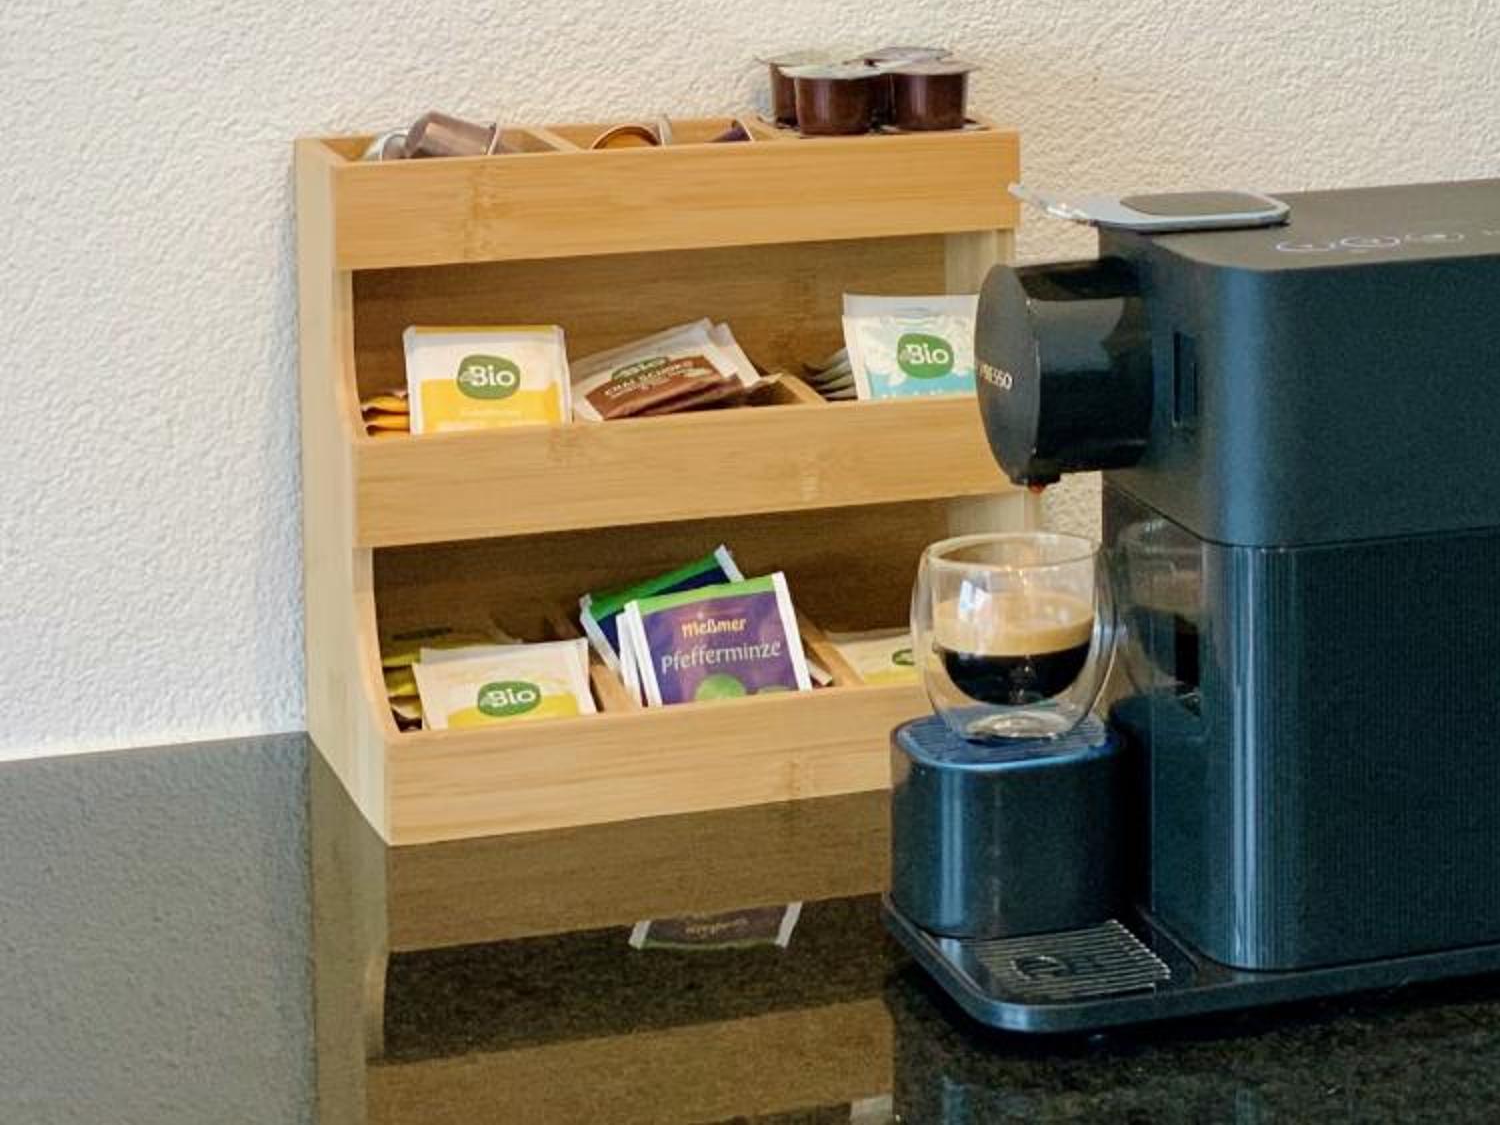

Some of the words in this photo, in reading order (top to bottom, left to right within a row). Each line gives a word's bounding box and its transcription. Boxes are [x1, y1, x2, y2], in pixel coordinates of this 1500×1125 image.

[905, 343, 949, 364] Bio
[469, 365, 515, 386] Bio
[661, 640, 781, 674] Pfefferminze
[488, 688, 536, 707] Bio
